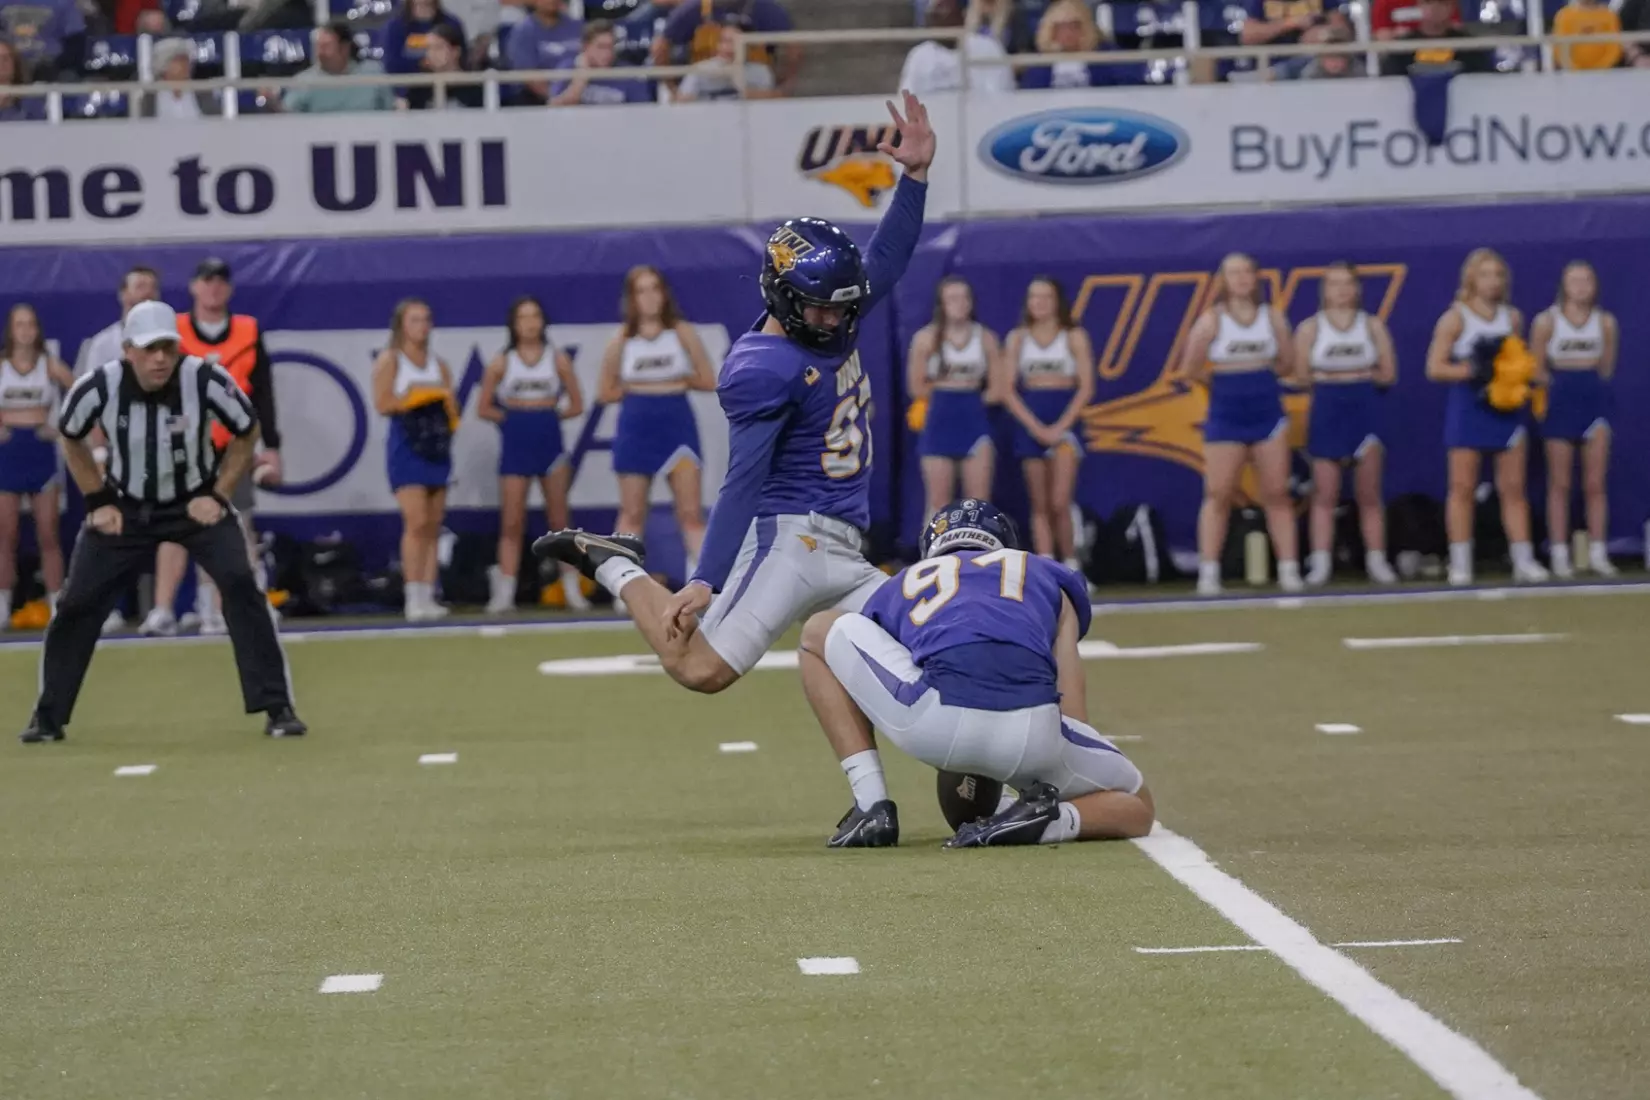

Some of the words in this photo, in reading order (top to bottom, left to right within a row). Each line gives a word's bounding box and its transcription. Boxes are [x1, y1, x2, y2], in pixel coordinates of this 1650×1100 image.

[1018, 119, 1150, 174] Ford
[172, 156, 276, 216] to
[311, 138, 507, 211] UNI
[939, 530, 998, 548] PANTHERS
[949, 510, 980, 523] 91
[902, 547, 1028, 626] 91
